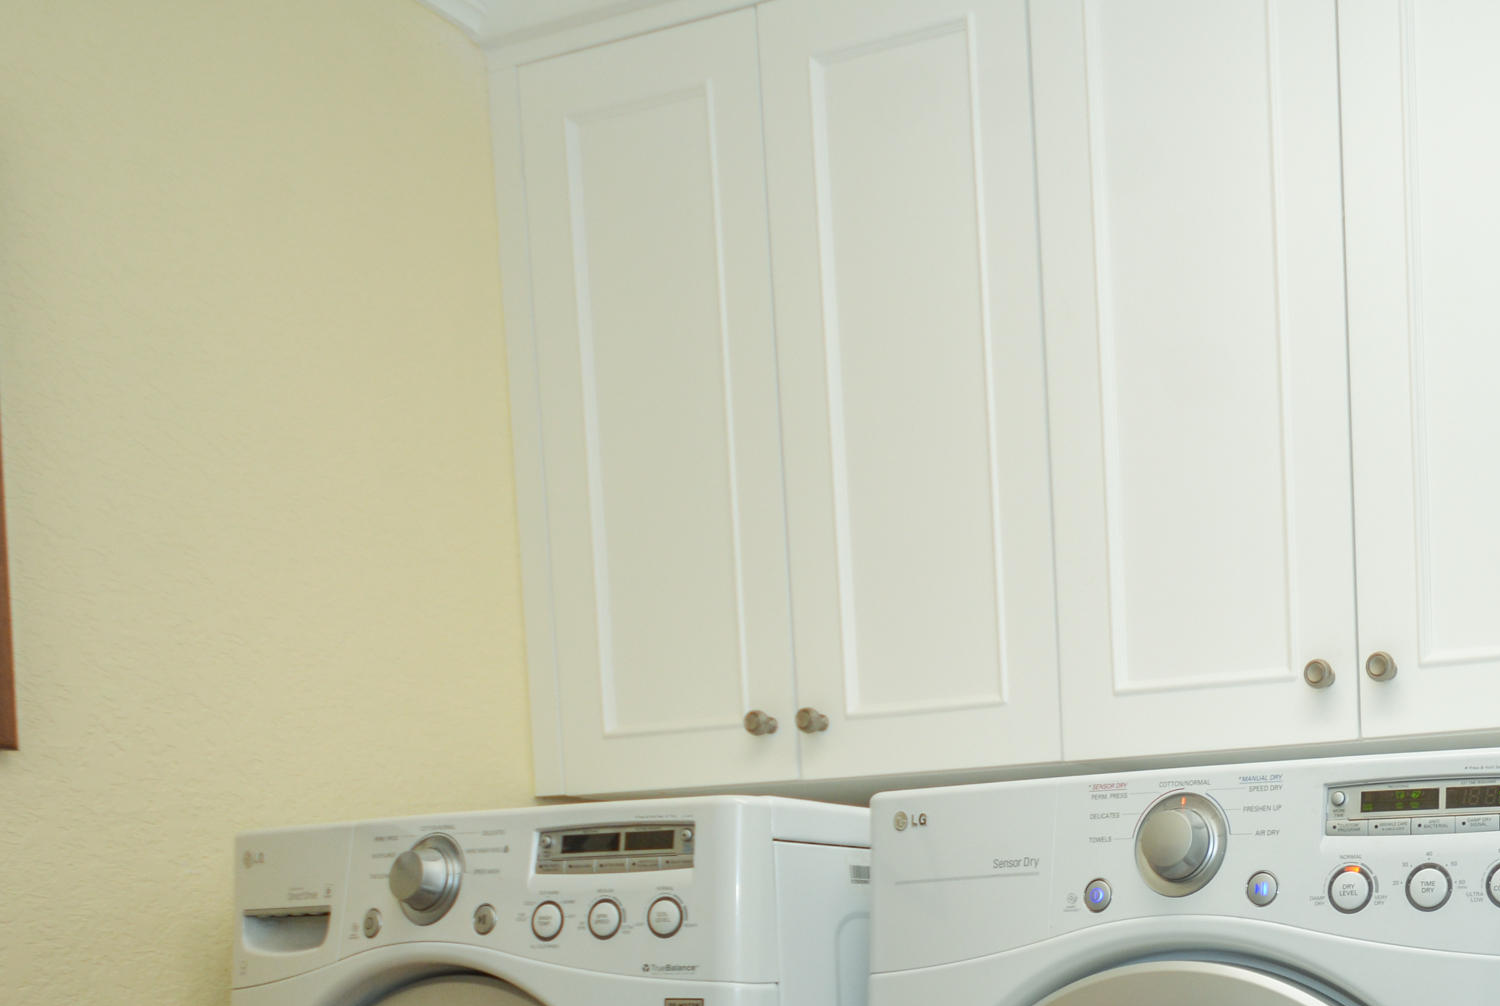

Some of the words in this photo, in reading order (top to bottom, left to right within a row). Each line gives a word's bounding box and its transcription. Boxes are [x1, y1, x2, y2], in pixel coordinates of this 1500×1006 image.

[911, 813, 928, 826] LG
[993, 858, 1022, 868] Sensor
[1024, 856, 1040, 868] Dry
